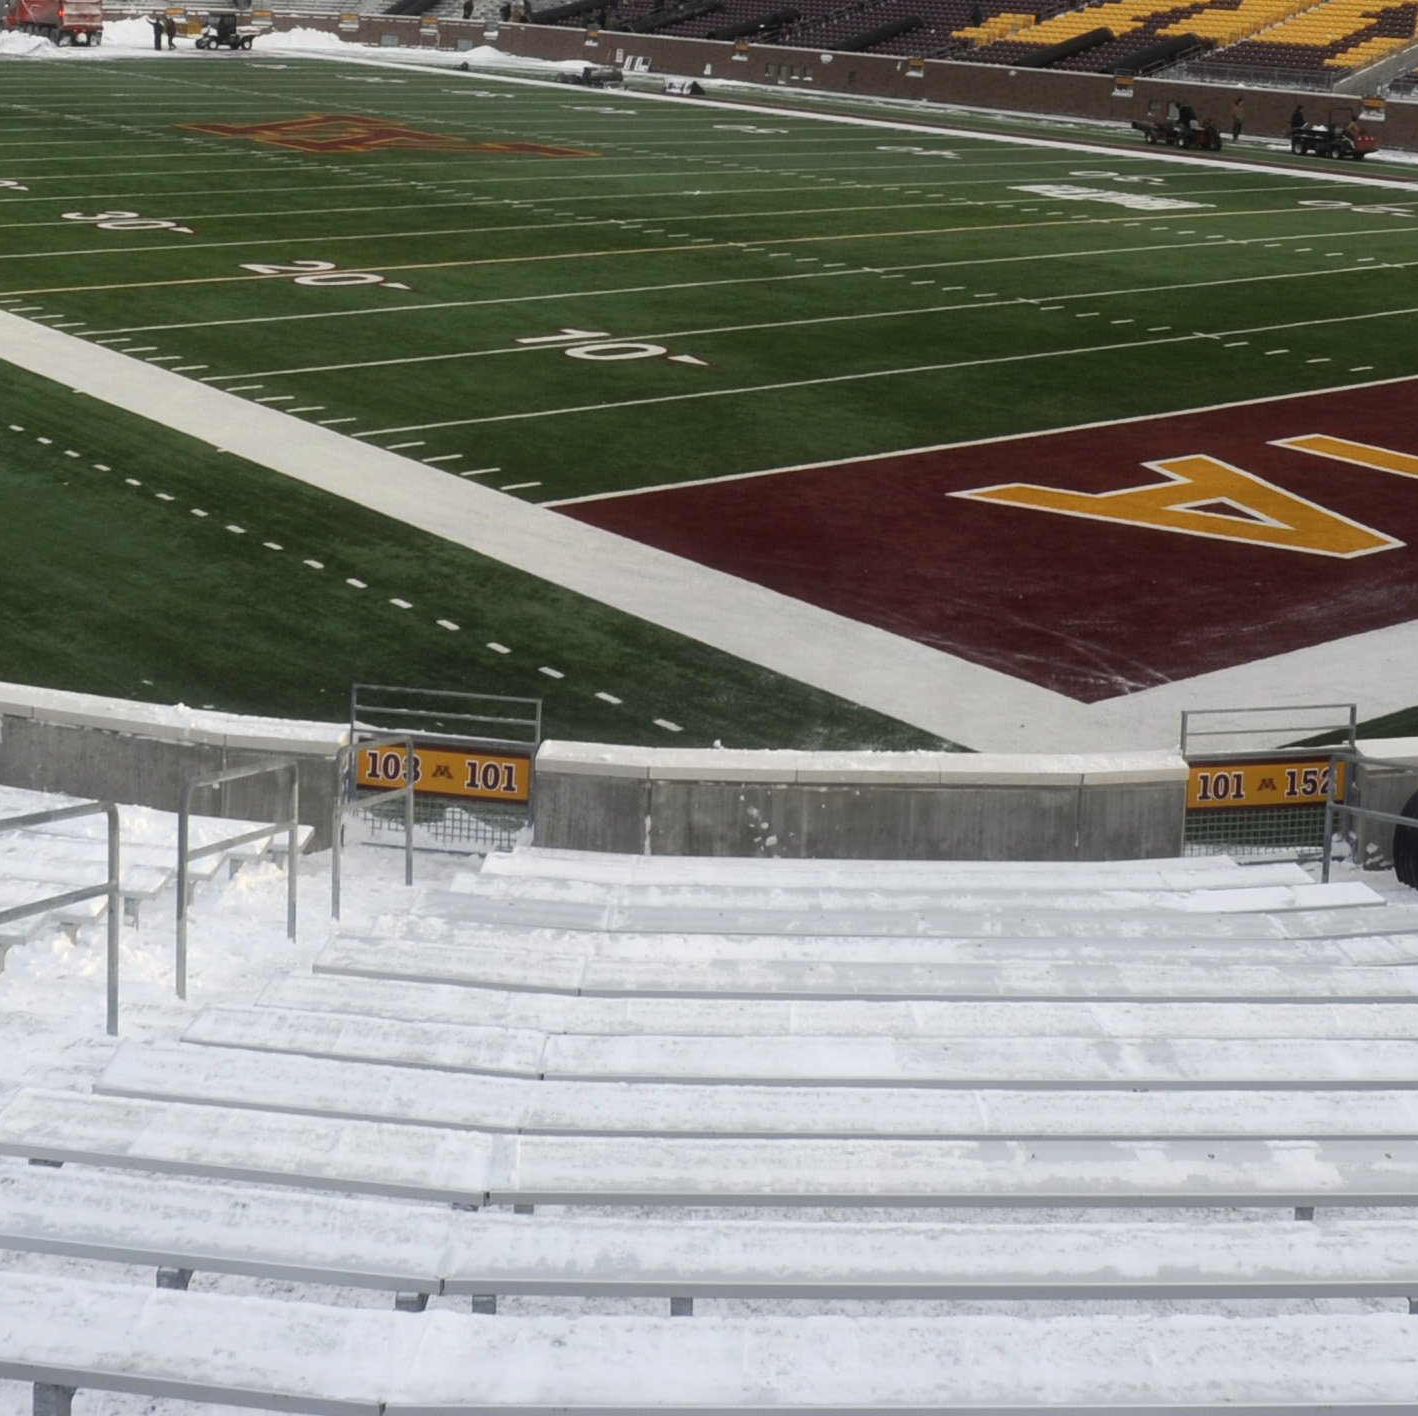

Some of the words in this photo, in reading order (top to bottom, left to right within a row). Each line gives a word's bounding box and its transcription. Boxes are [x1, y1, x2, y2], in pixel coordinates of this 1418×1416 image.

[61, 210, 177, 230] 30
[239, 260, 385, 286] 20
[516, 329, 669, 364] 10
[366, 750, 422, 783] 103
[464, 759, 518, 793] 101
[1197, 770, 1245, 801] 101
